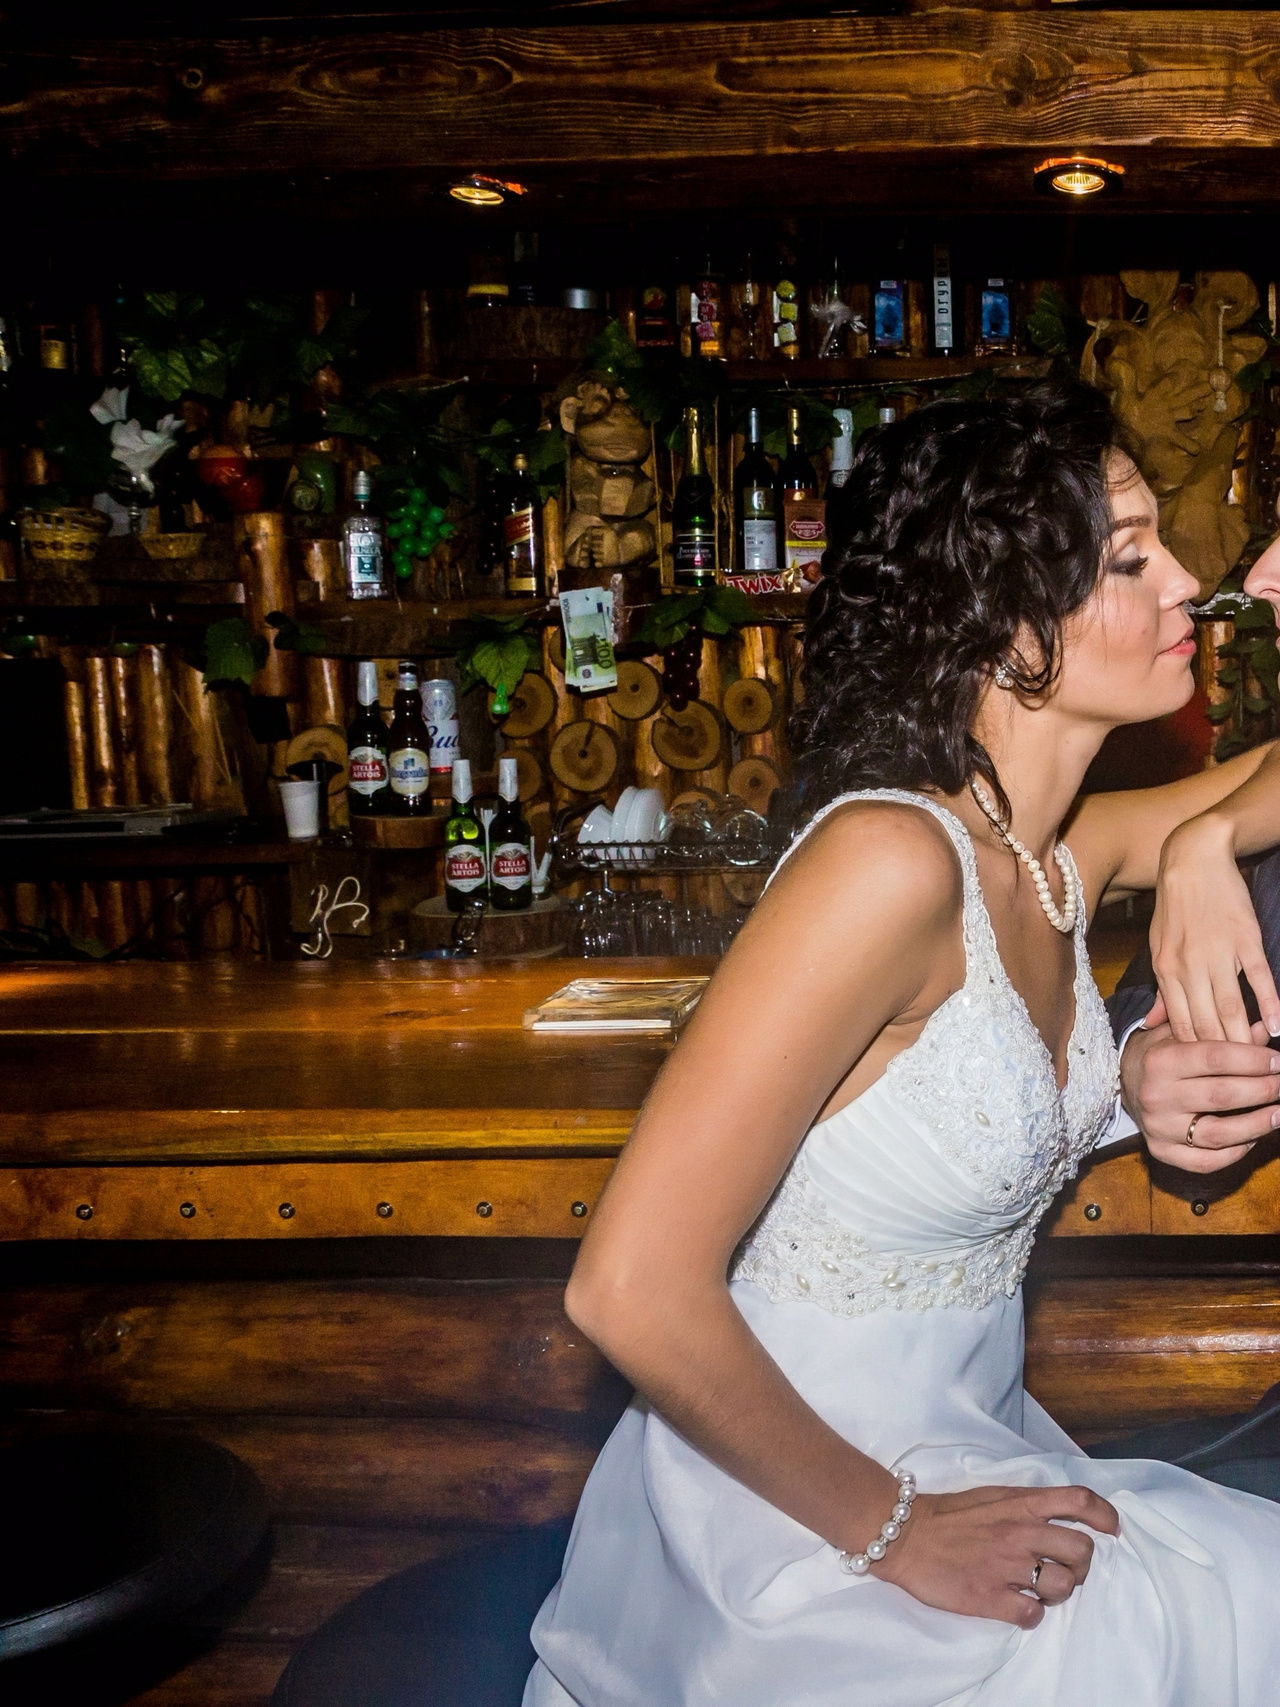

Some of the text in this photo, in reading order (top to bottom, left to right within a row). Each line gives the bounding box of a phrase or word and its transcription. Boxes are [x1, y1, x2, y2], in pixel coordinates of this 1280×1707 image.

[597, 640, 613, 669] 100
[352, 764, 380, 772] STELLA
[352, 770, 381, 778] ARTOIS
[451, 862, 479, 870] STELLA
[499, 860, 527, 868] STELLA
[499, 866, 527, 874] ARTOIS
